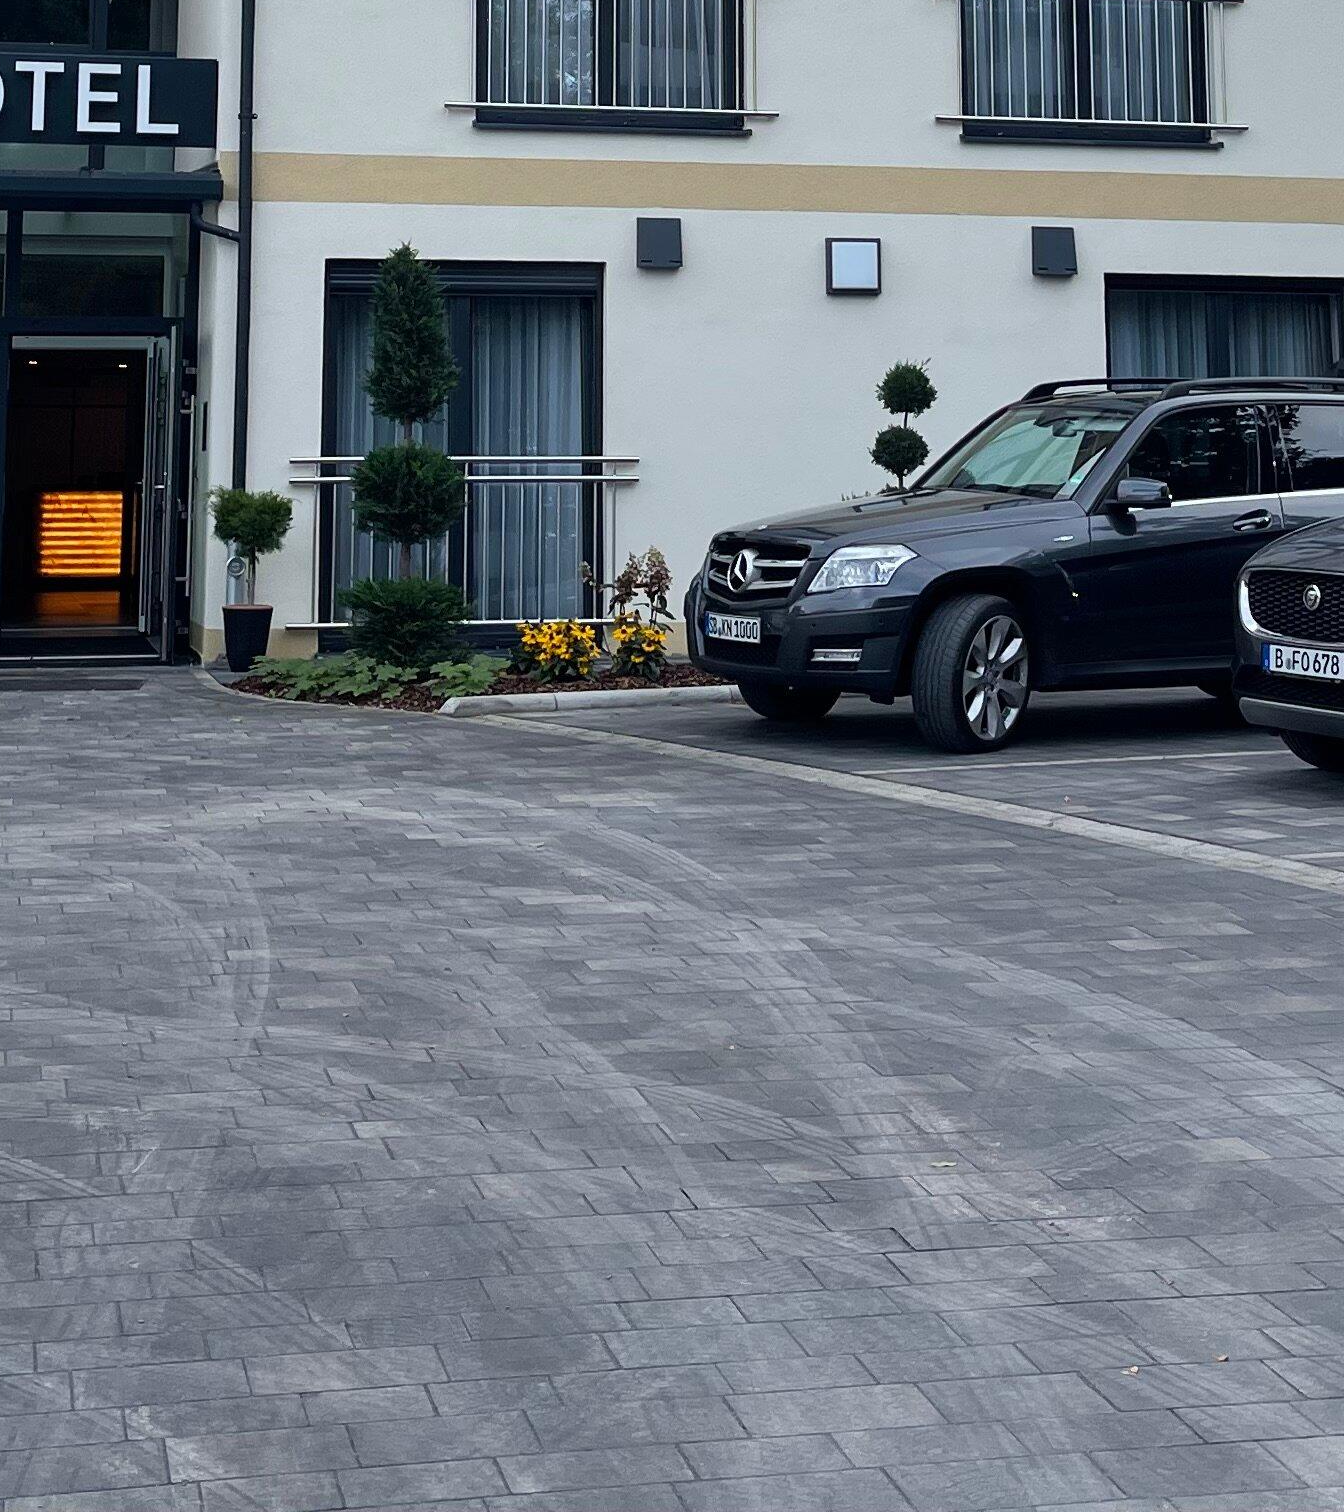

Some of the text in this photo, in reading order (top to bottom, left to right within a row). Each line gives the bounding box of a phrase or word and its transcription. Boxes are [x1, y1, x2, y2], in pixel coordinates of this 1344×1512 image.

[734, 620, 758, 640] 1000
[1275, 648, 1284, 669] B
[1313, 653, 1340, 676] 678
